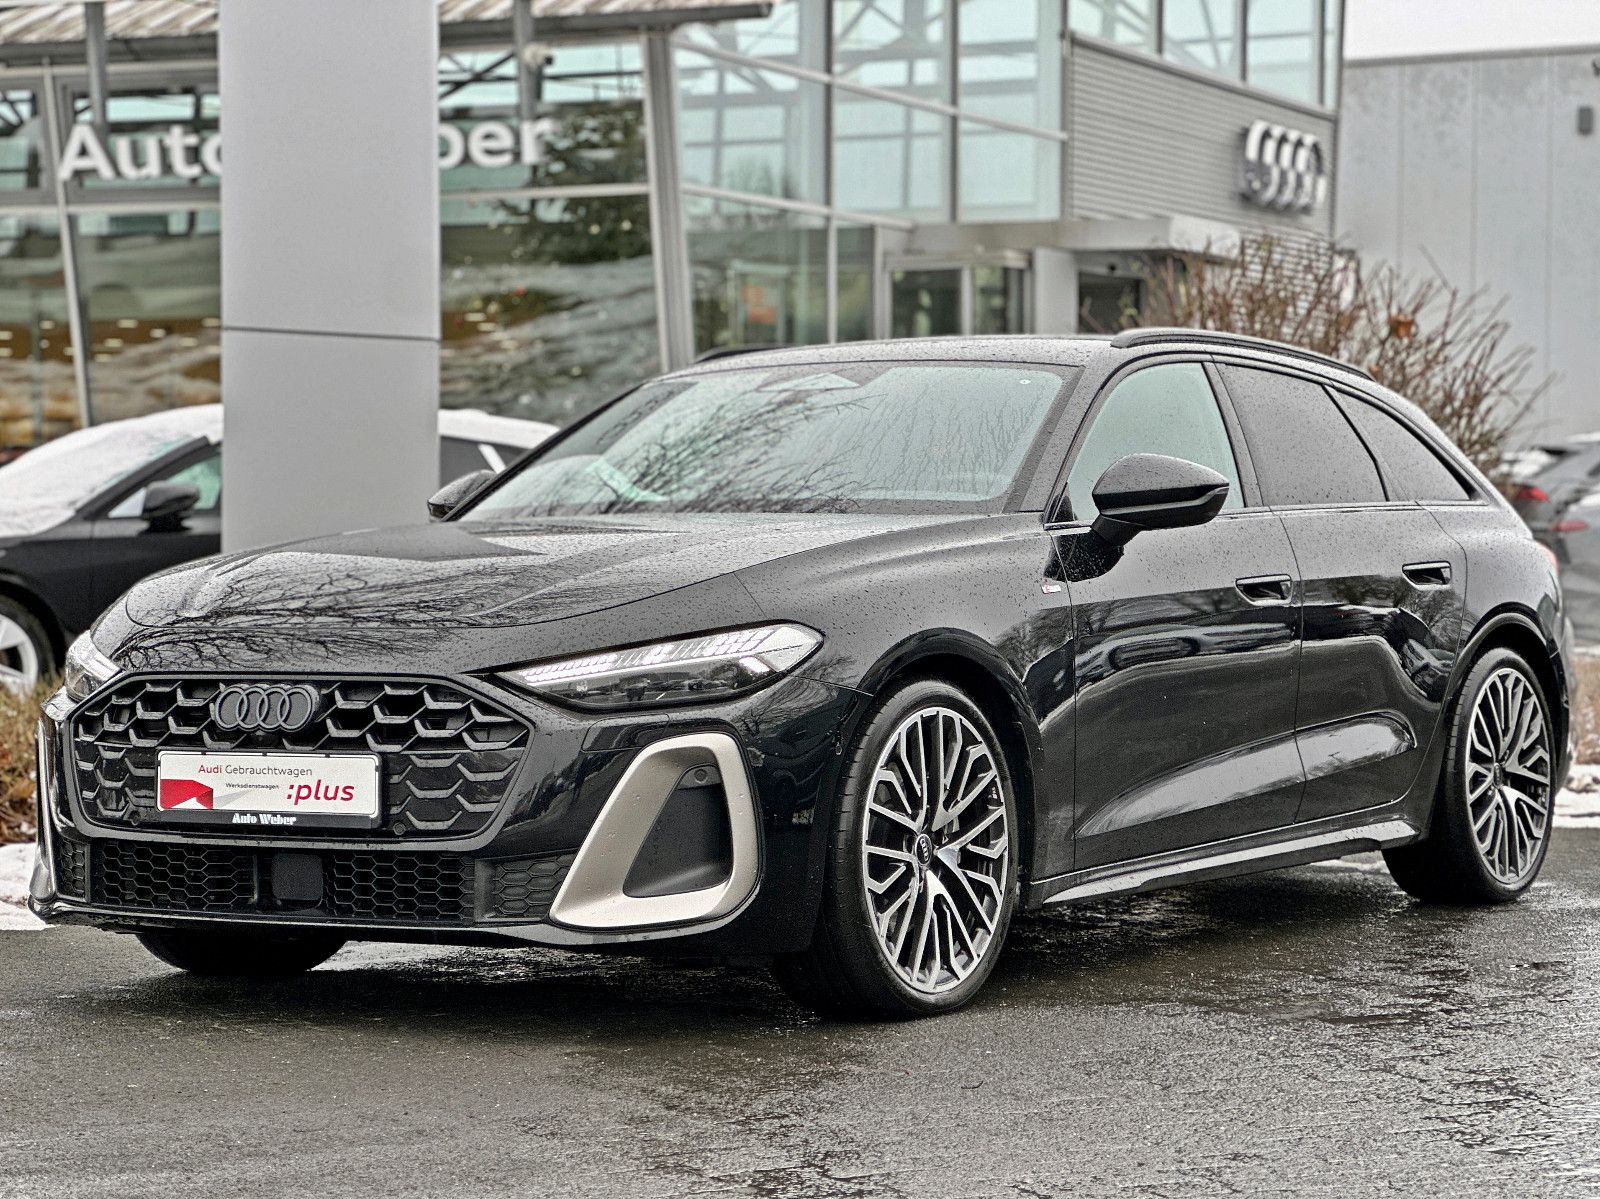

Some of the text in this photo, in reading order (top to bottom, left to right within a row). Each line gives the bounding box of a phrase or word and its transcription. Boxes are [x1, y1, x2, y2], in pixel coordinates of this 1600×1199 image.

[198, 764, 312, 777] Audi Gebrauchtwagen
[225, 782, 279, 790] Werksdienstwagen
[286, 779, 354, 805] :plus
[232, 813, 296, 825] Auto Weber
